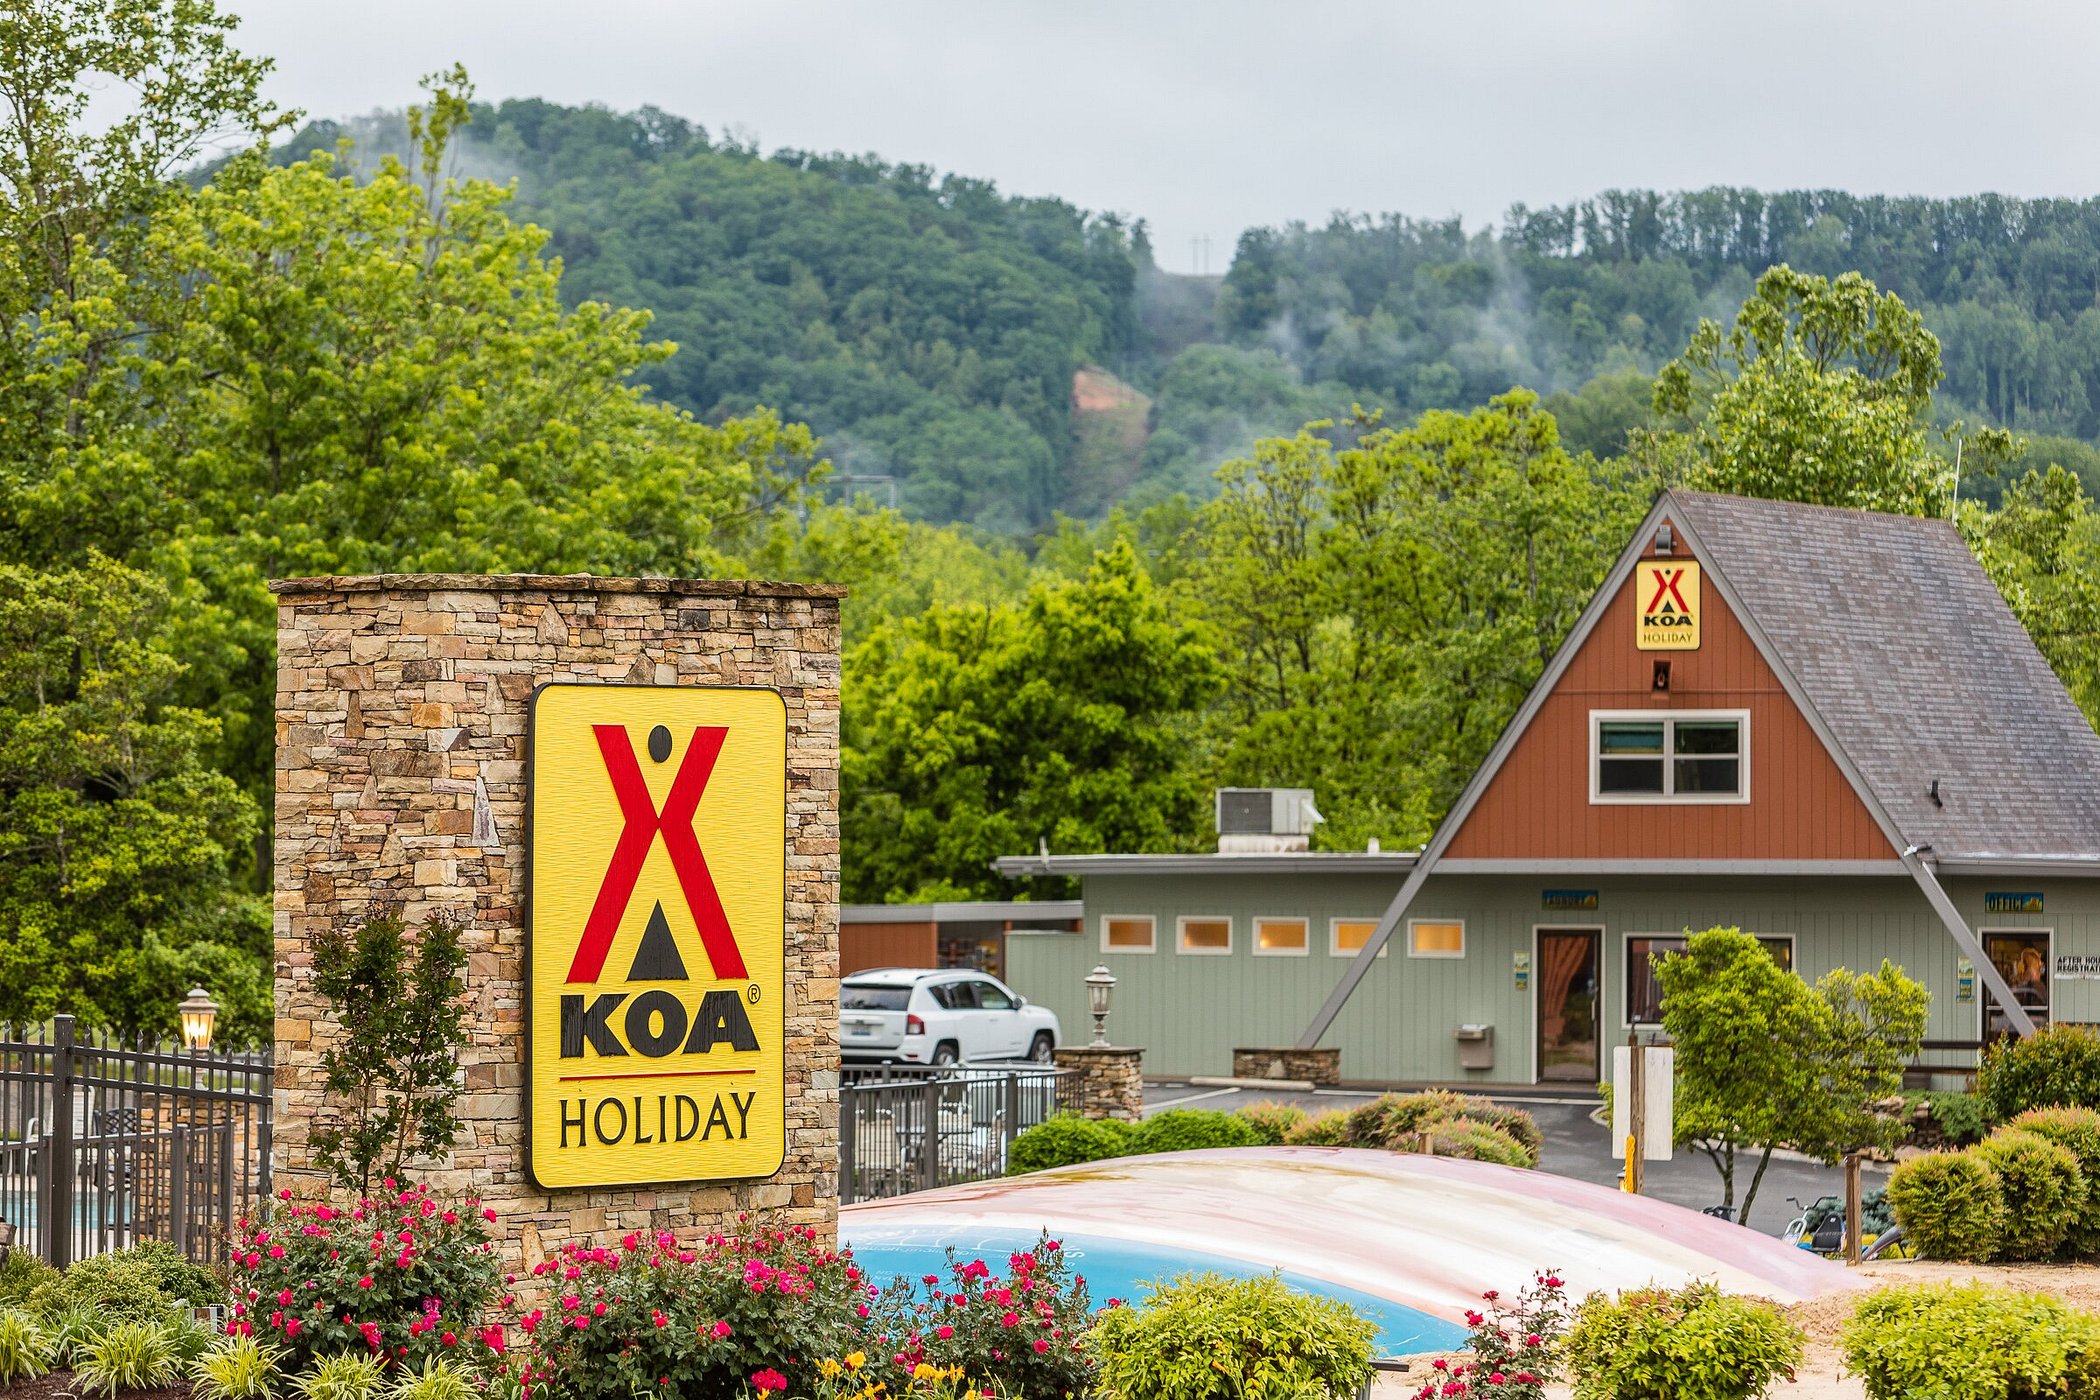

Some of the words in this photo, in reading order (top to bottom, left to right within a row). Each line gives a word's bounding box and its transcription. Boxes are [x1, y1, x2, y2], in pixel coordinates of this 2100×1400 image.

[1644, 615, 1693, 626] KOA
[1643, 632, 1693, 643] HOLIDAY
[2057, 956, 2082, 964] AFTER
[559, 1091, 757, 1148] HOLIDAY
